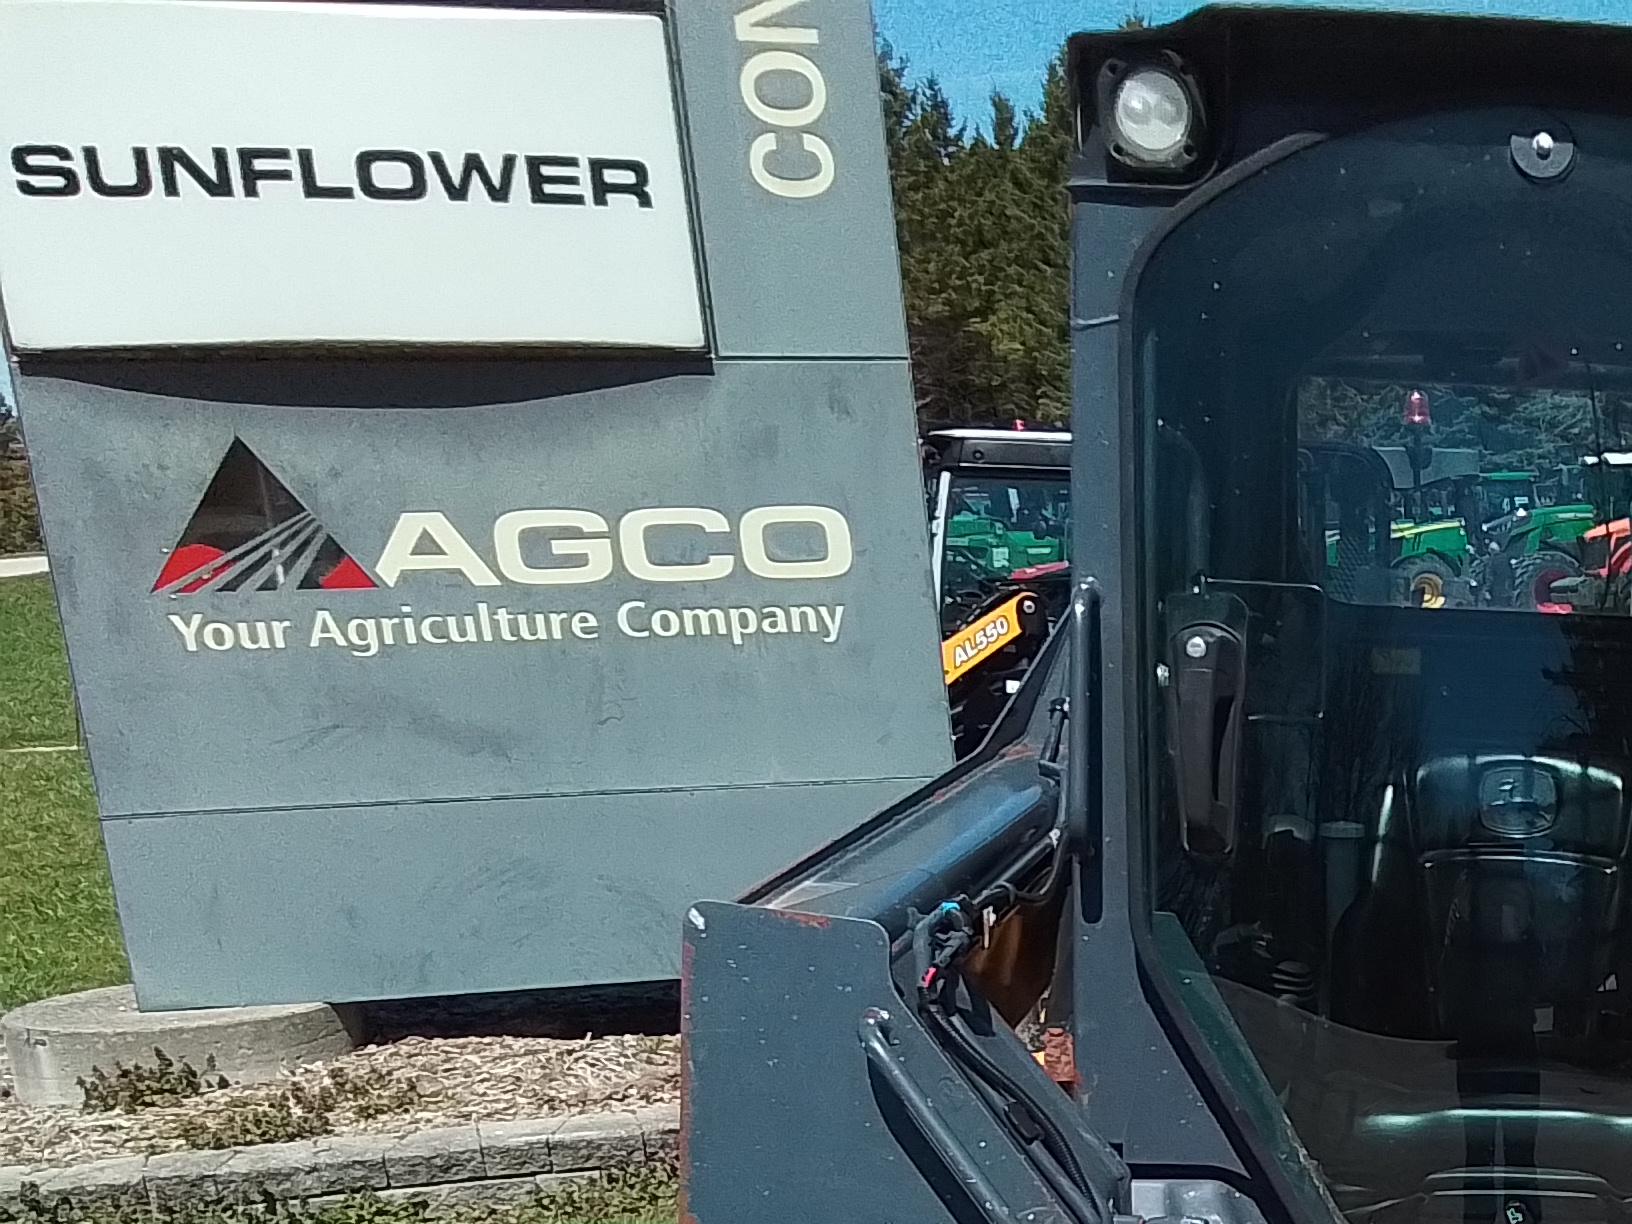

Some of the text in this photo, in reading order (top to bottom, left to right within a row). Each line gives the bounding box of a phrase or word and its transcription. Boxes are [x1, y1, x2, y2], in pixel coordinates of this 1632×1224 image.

[10, 144, 654, 209] SUNFLOWER
[374, 505, 853, 588] AGCO
[168, 600, 844, 657] Your Agriculture Company
[955, 616, 1008, 667] AL550
